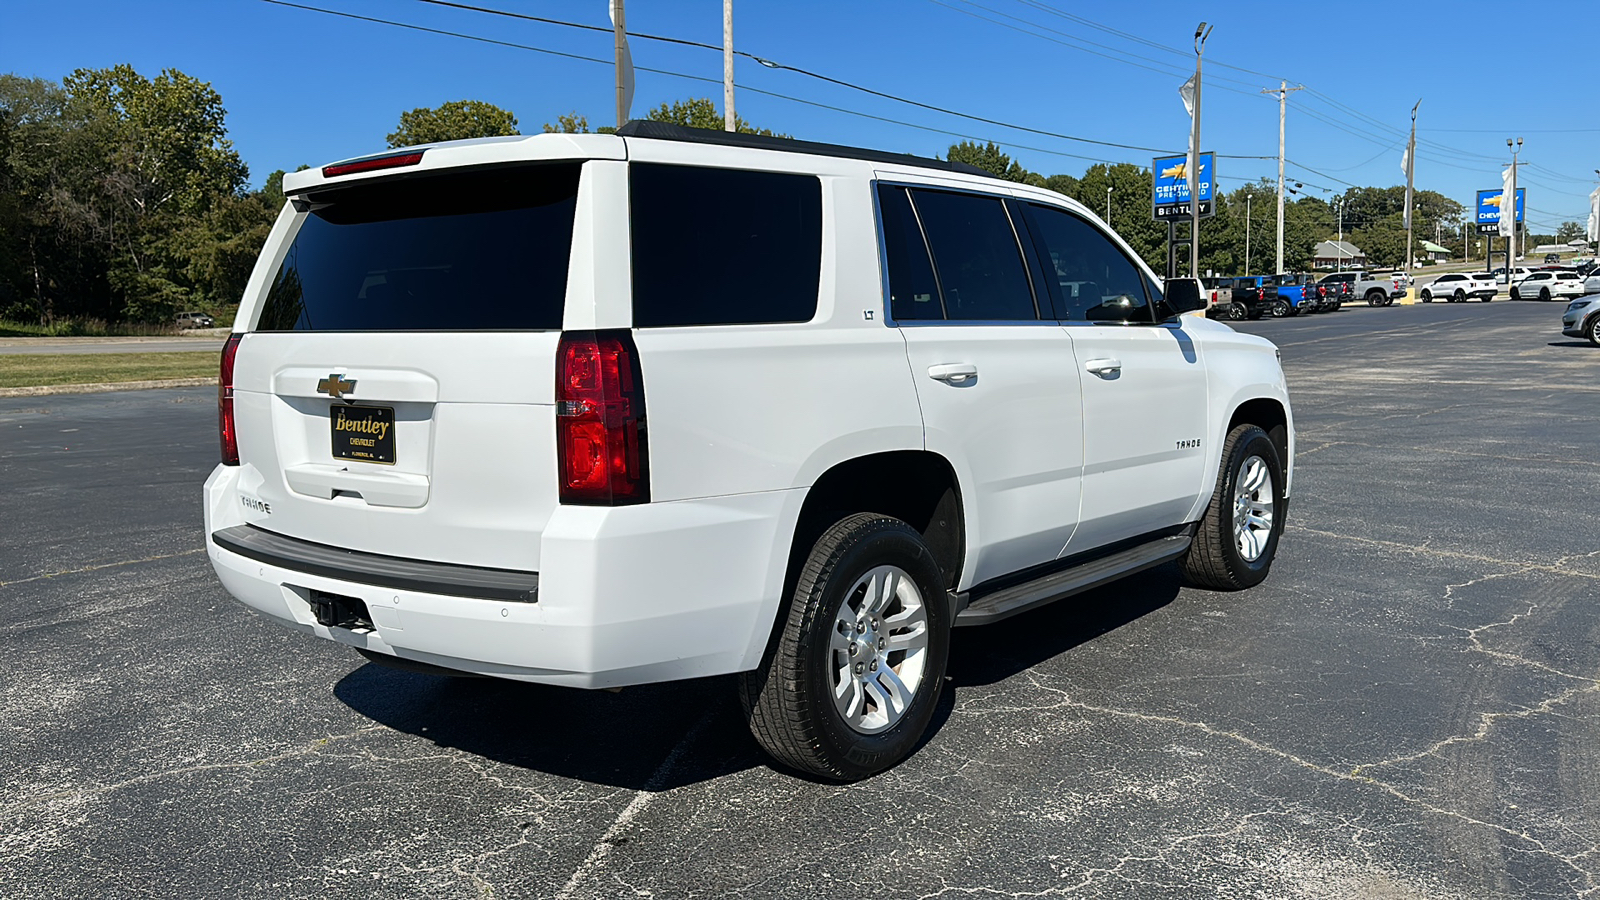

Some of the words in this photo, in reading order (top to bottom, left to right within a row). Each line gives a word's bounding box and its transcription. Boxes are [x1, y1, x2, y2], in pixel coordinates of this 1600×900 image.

[1155, 182, 1210, 193] CERTID
[1158, 188, 1206, 199] PRE-OWD
[1158, 204, 1206, 216] BENTLY
[863, 310, 874, 320] LT
[335, 412, 390, 440] Bentley
[349, 437, 376, 447] CHEVROLET
[1175, 438, 1201, 450] TAHOE
[240, 495, 272, 514] TAHOE
